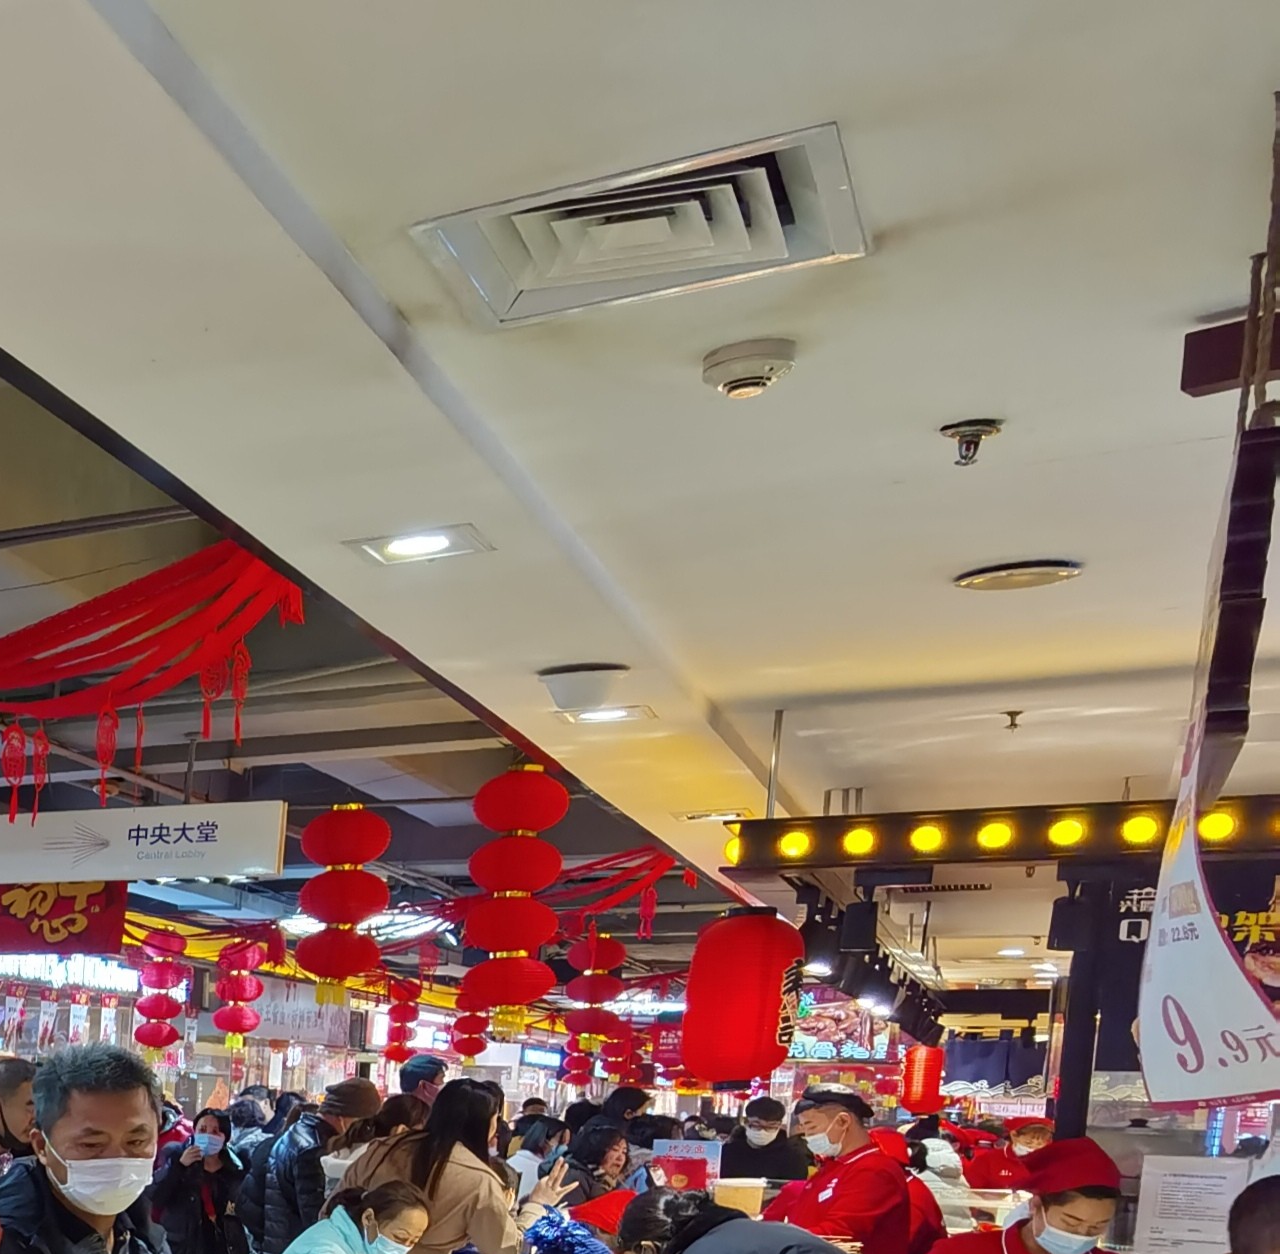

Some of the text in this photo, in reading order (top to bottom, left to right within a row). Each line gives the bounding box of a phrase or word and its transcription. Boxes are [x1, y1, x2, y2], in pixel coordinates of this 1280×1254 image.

[127, 820, 220, 847] 中央大堂
[136, 848, 207, 863] Central Lobby
